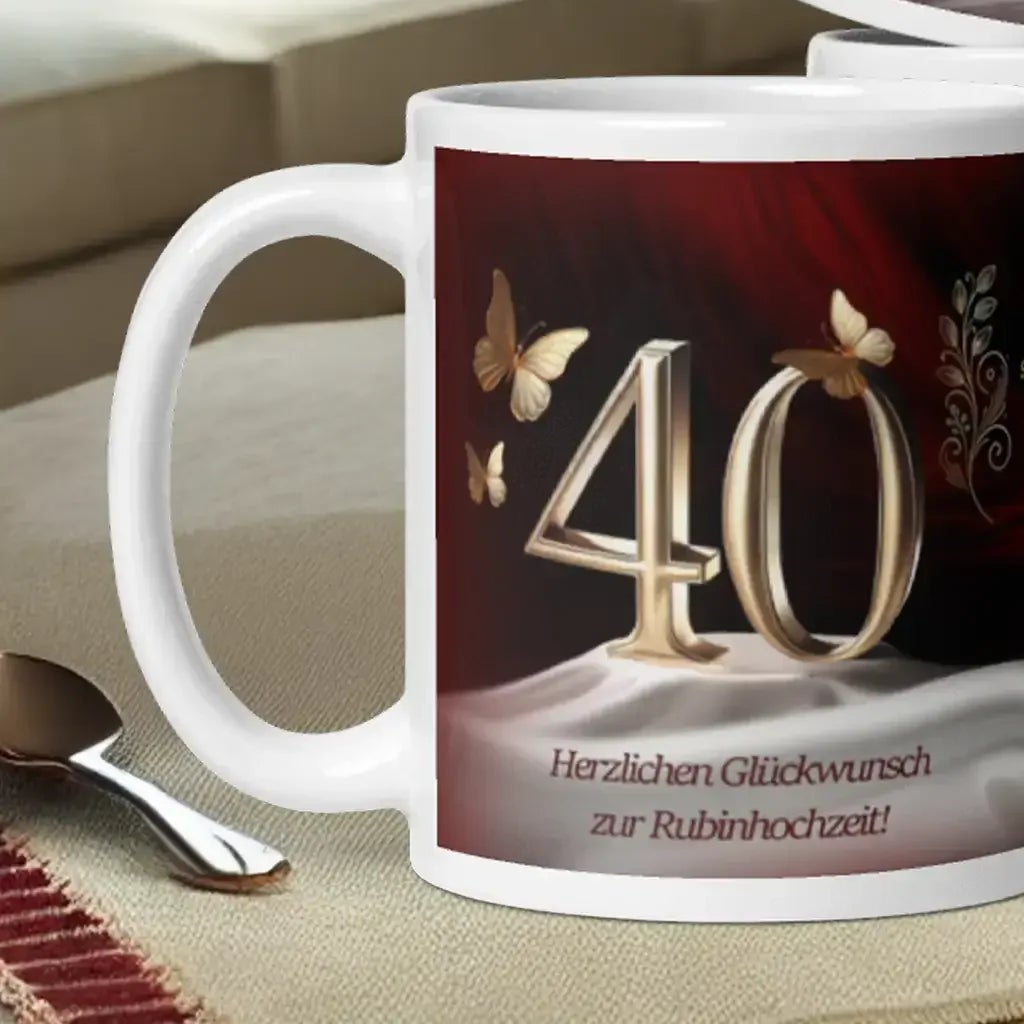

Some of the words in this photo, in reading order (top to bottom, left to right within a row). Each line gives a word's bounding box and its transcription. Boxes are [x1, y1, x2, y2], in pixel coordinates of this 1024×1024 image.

[524, 338, 926, 664] 40
[550, 747, 713, 788] Herzlichen
[720, 745, 932, 788] Glückwunsch
[590, 810, 645, 839] zur
[649, 805, 891, 842] Rubinhochzeit!
